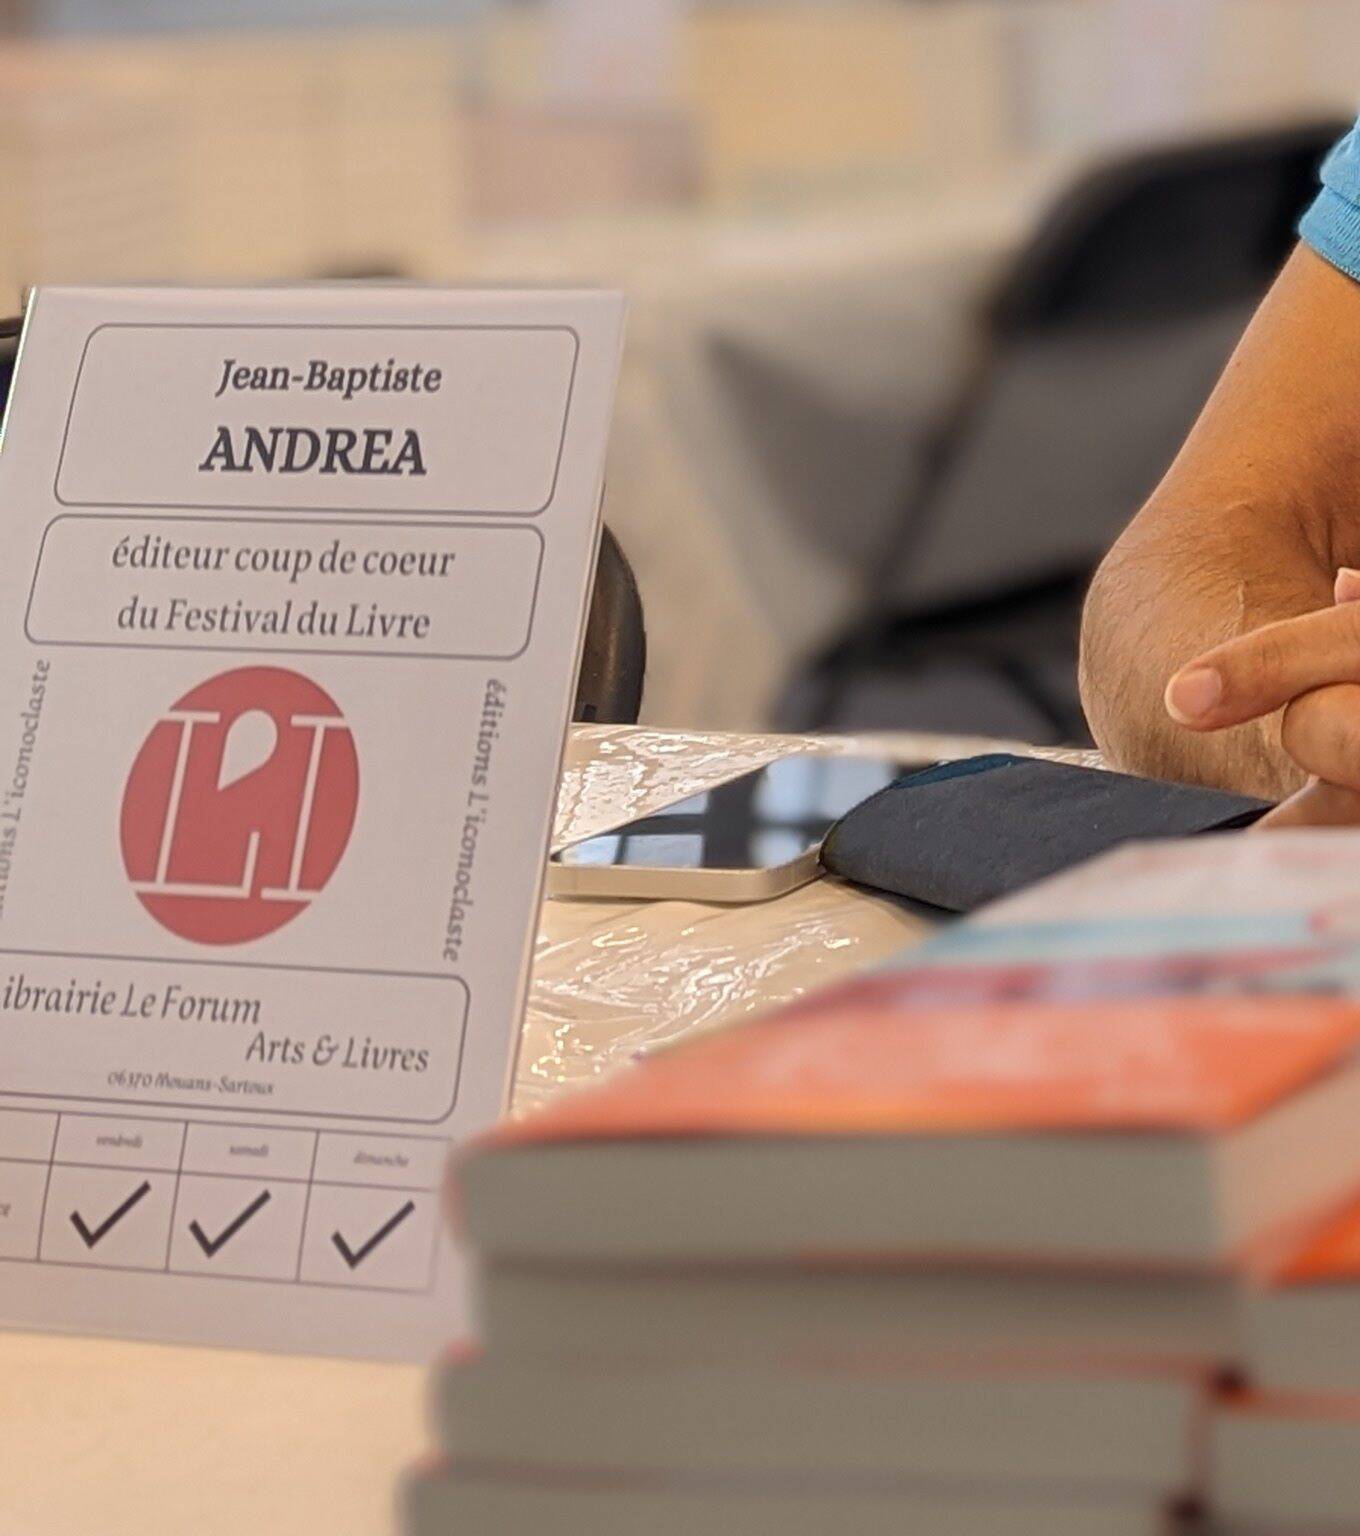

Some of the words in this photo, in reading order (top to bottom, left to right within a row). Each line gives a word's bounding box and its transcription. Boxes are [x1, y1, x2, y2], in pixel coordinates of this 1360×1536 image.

[215, 358, 442, 400] Jean-Baptiste
[199, 426, 427, 476] ANDREA
[111, 534, 229, 571] éditeur
[234, 545, 315, 582] coup
[318, 539, 359, 575] de
[363, 548, 455, 578] coeur
[117, 595, 158, 631] du
[165, 598, 291, 637] Festival
[297, 601, 340, 637] du
[345, 602, 431, 640] Livre
[471, 678, 507, 786] éditions
[442, 790, 490, 962] L'iconoclaste
[3, 975, 117, 1016] ibrairie
[120, 983, 156, 1019] Le
[160, 985, 262, 1025] Forum
[245, 1031, 306, 1065] Arts
[312, 1035, 340, 1067] &
[342, 1037, 430, 1073] Livres
